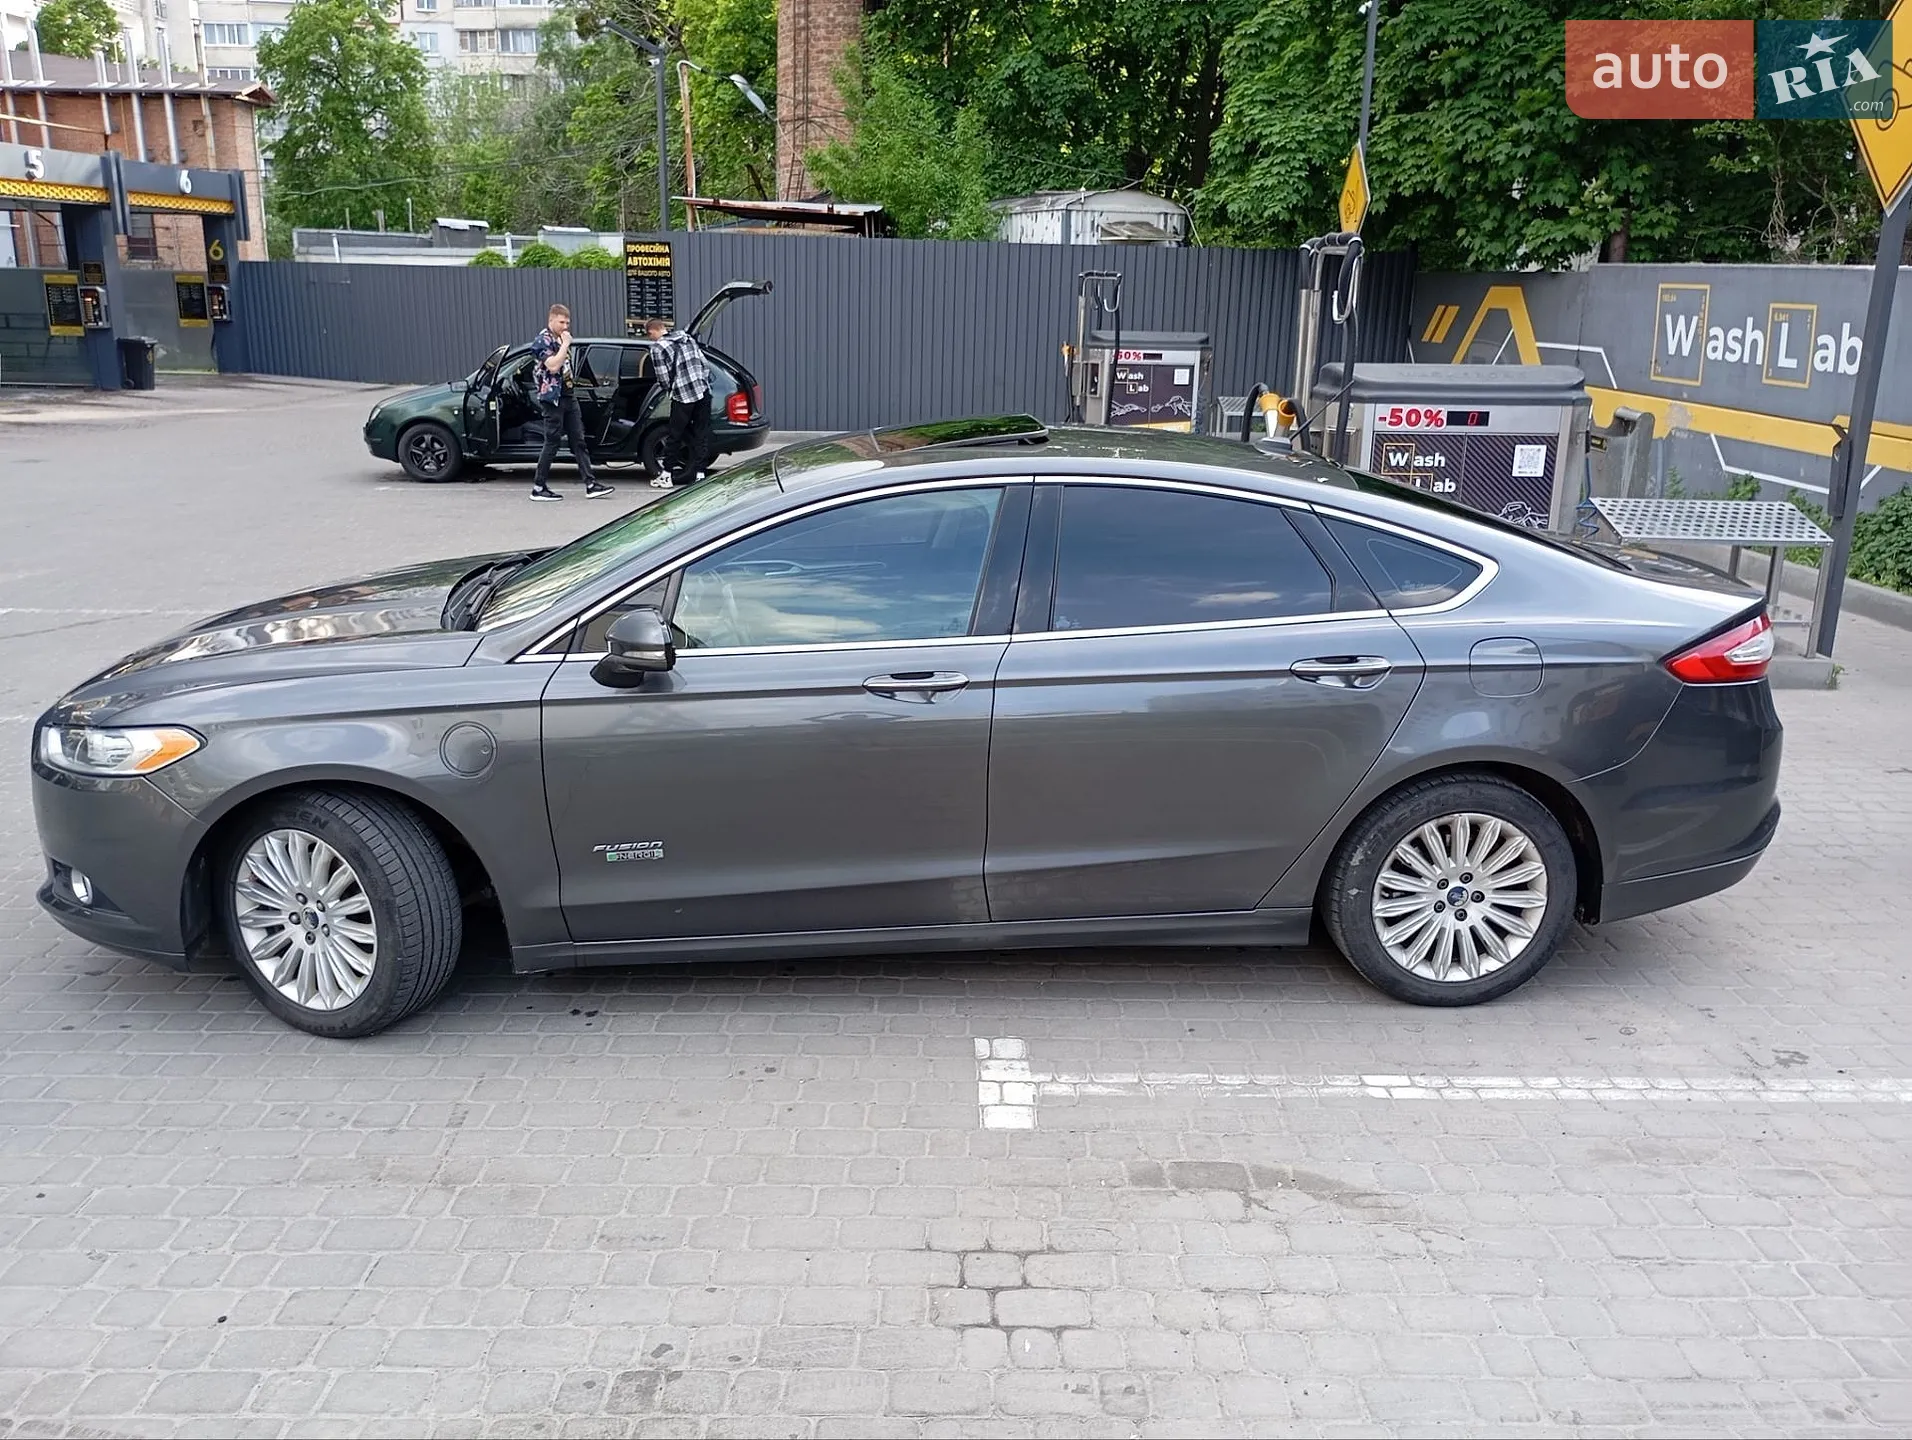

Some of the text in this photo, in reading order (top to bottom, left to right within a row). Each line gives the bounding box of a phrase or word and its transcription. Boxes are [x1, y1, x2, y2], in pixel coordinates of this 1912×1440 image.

[25, 149, 45, 180] 5
[179, 169, 193, 194] 6
[209, 239, 224, 261] 6
[627, 256, 671, 267] АВТОХІМІЯ
[1665, 313, 1765, 365] Wash
[1777, 321, 1863, 376] Lab
[1116, 371, 1144, 380] Wash
[1129, 384, 1149, 392] Lab
[1378, 407, 1445, 428] -50%
[1467, 412, 1479, 425] 0
[1388, 452, 1446, 467] Wash
[592, 841, 663, 852] FUSION
